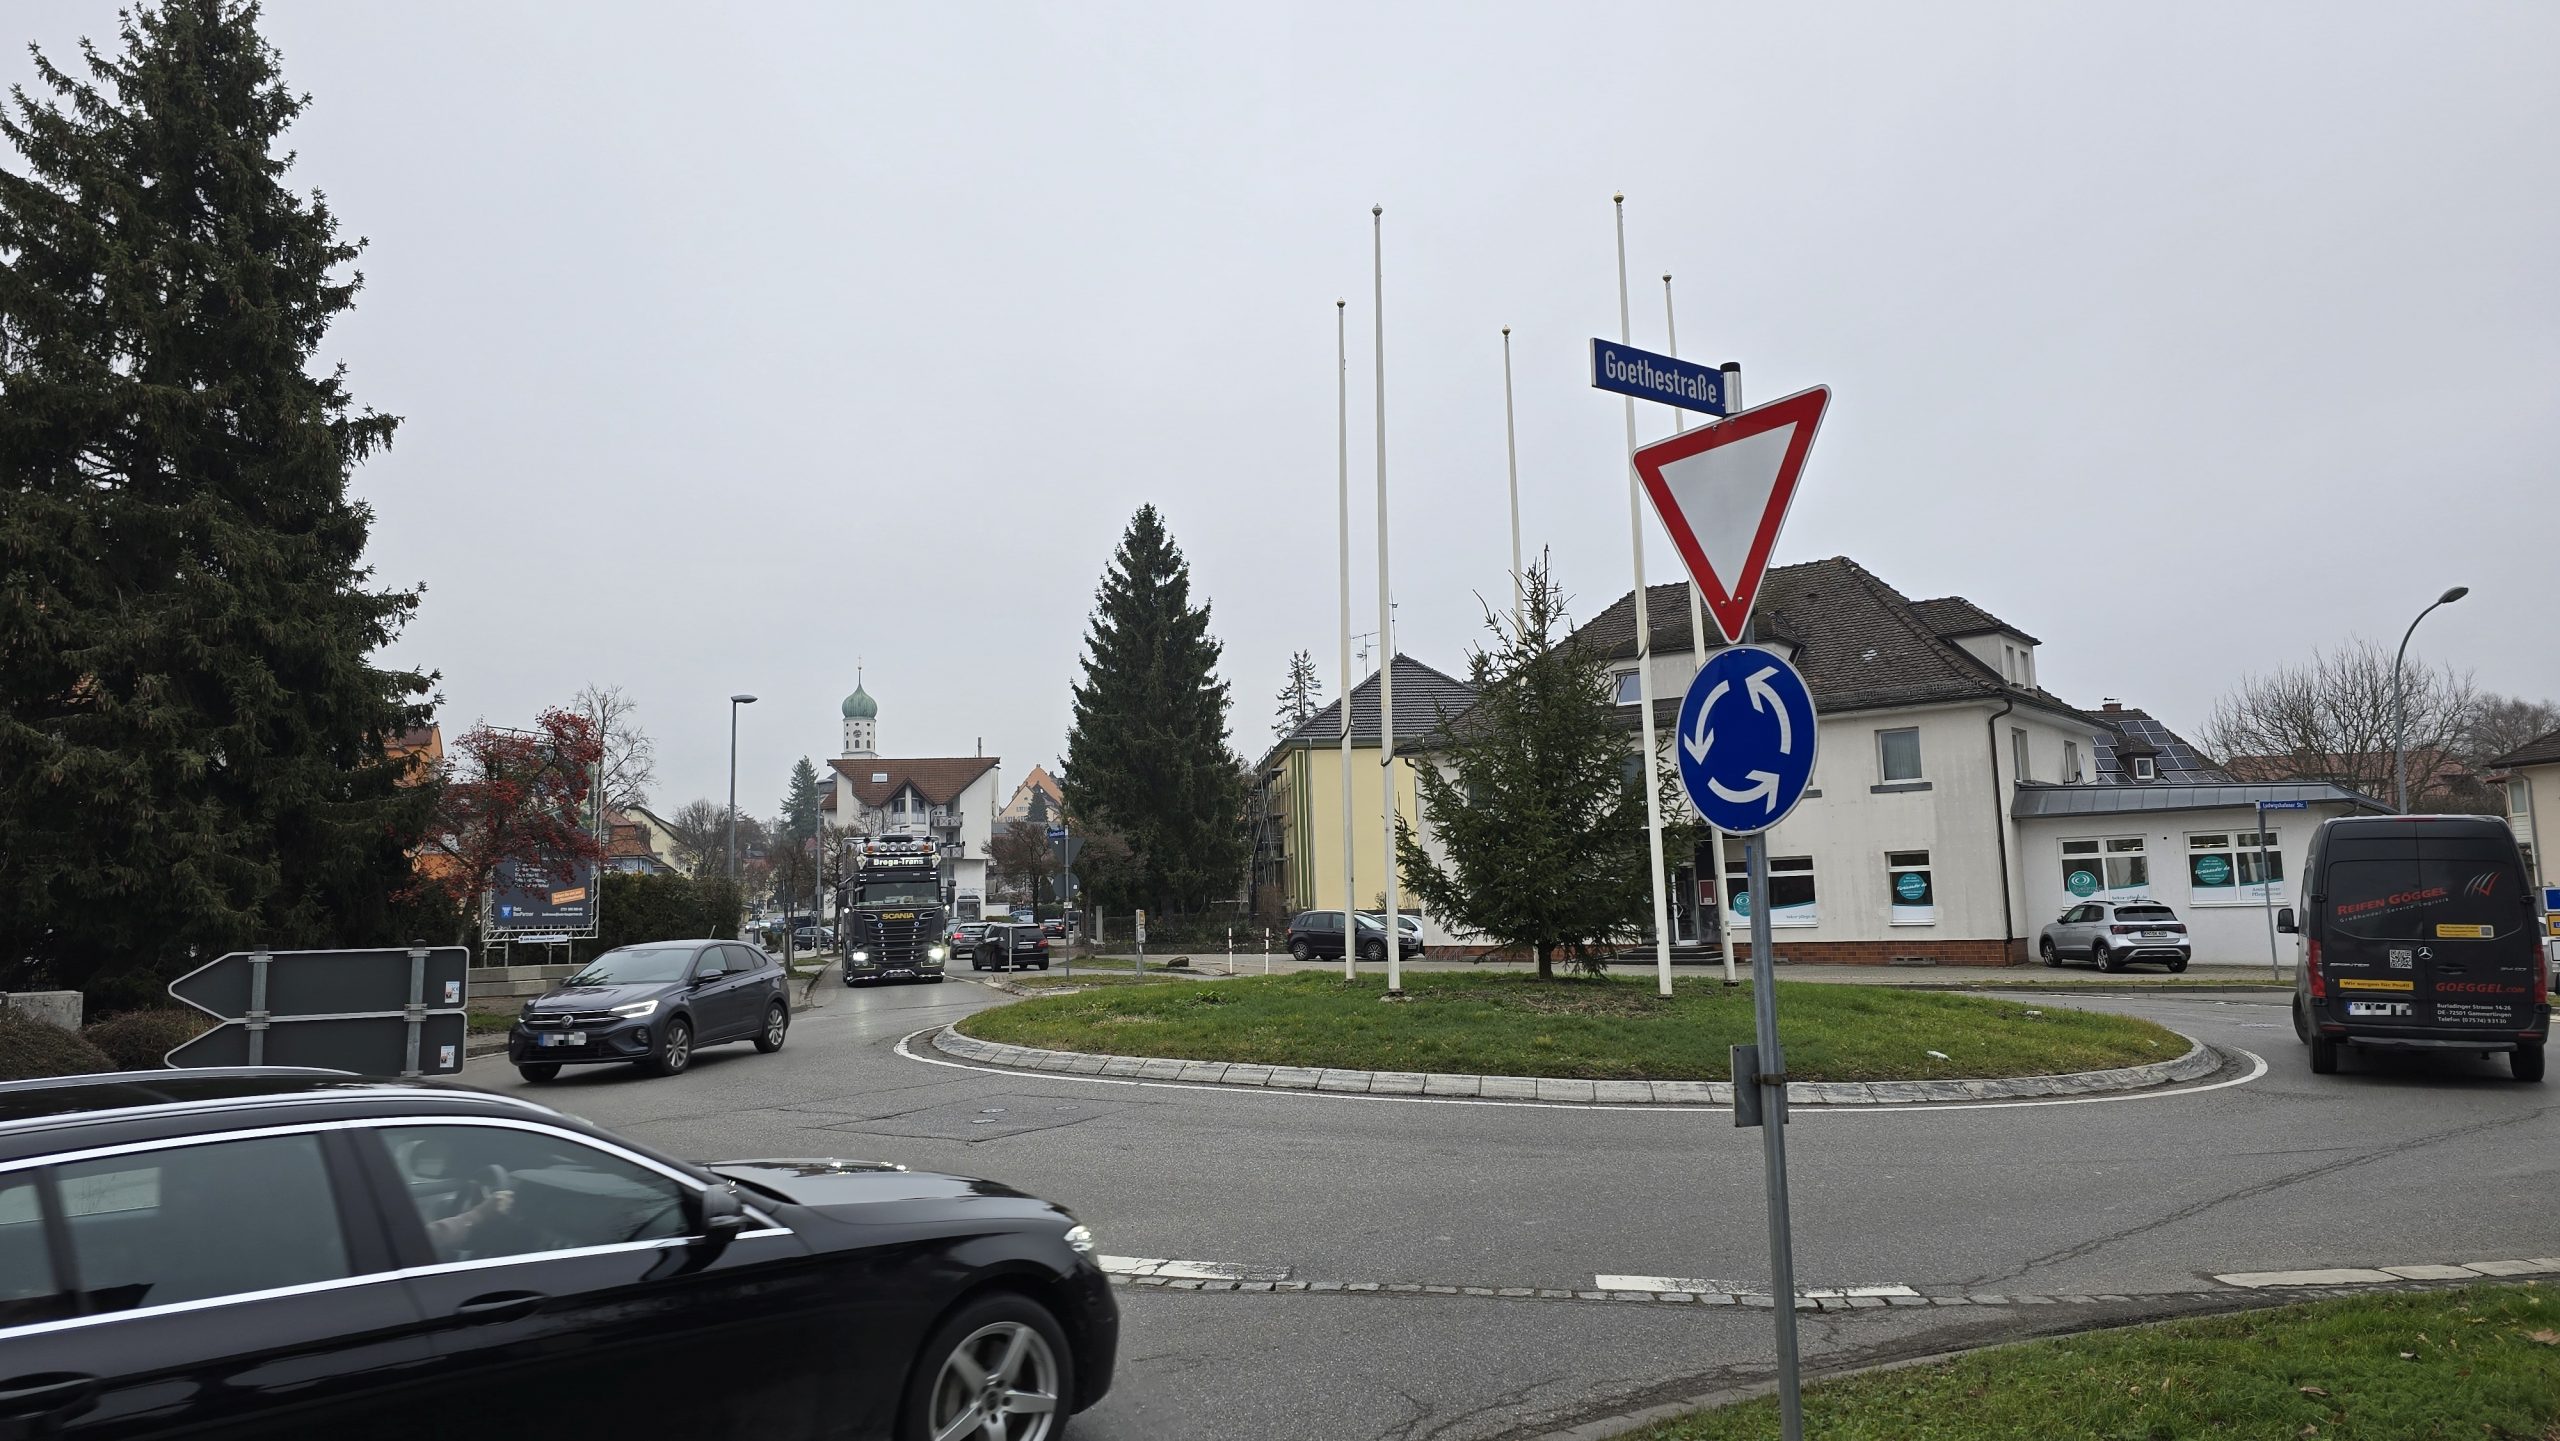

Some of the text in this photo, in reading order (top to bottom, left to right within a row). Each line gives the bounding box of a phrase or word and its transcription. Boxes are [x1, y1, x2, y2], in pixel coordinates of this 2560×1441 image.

[1605, 350, 1717, 404] Goethestraße
[2337, 887, 2448, 915] REIFEN GÖGGEL
[882, 912, 915, 920] SCANIA
[2435, 982, 2526, 993] GOEGGEL.com
